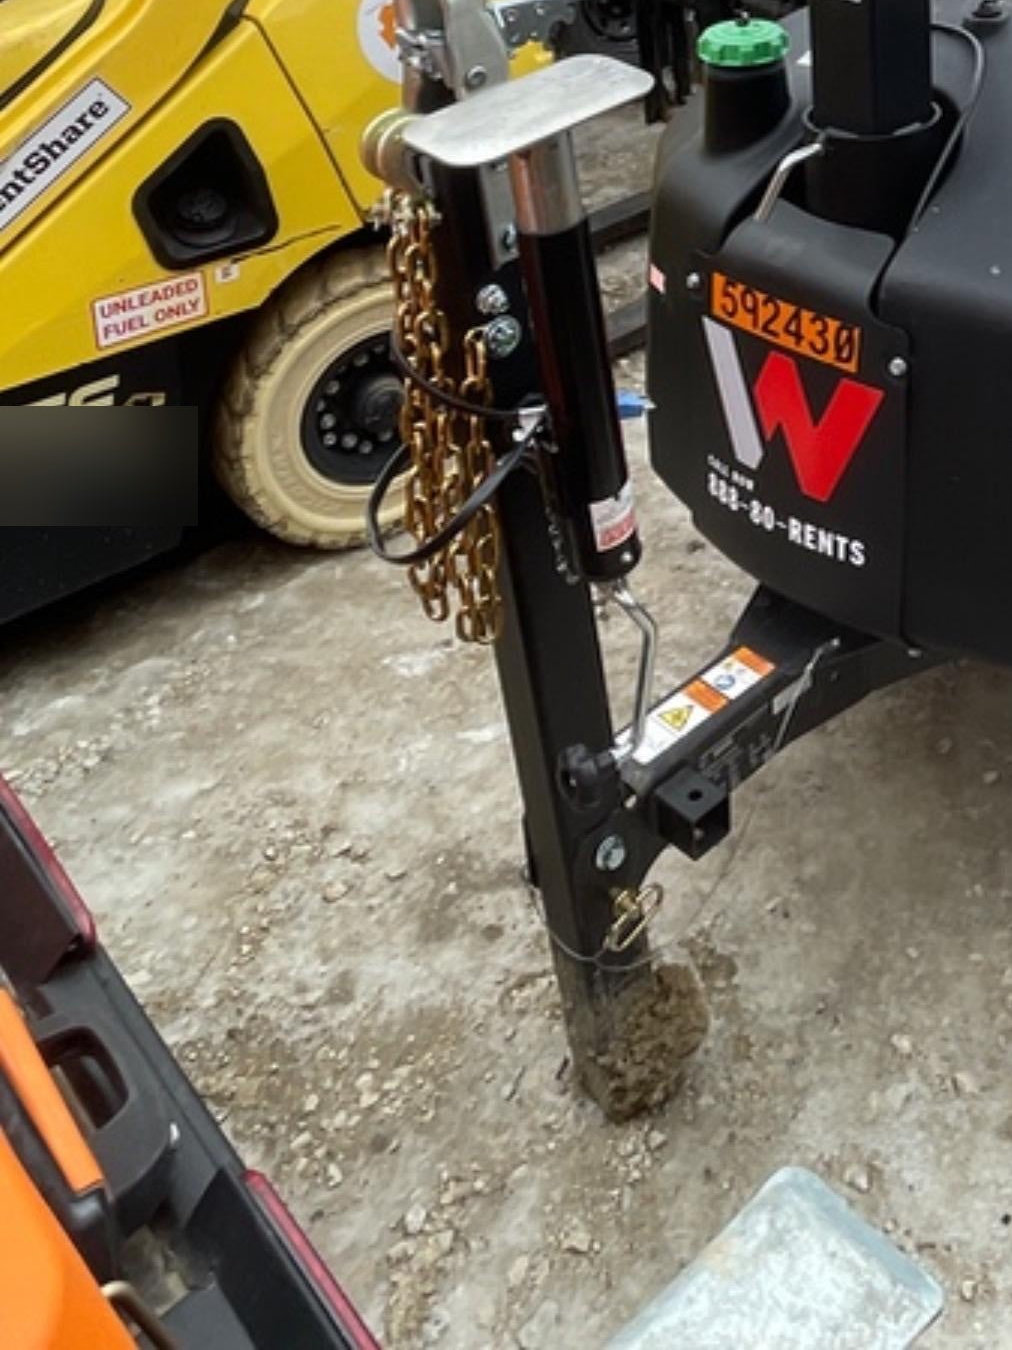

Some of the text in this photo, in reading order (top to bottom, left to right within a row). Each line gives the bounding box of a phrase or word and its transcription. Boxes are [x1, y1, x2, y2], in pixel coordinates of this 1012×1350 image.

[100, 278, 199, 319] UNLEADED
[103, 298, 199, 340] FUEL ONLY
[721, 280, 856, 364] 592430
[707, 472, 865, 566] 888-80-RENTS
